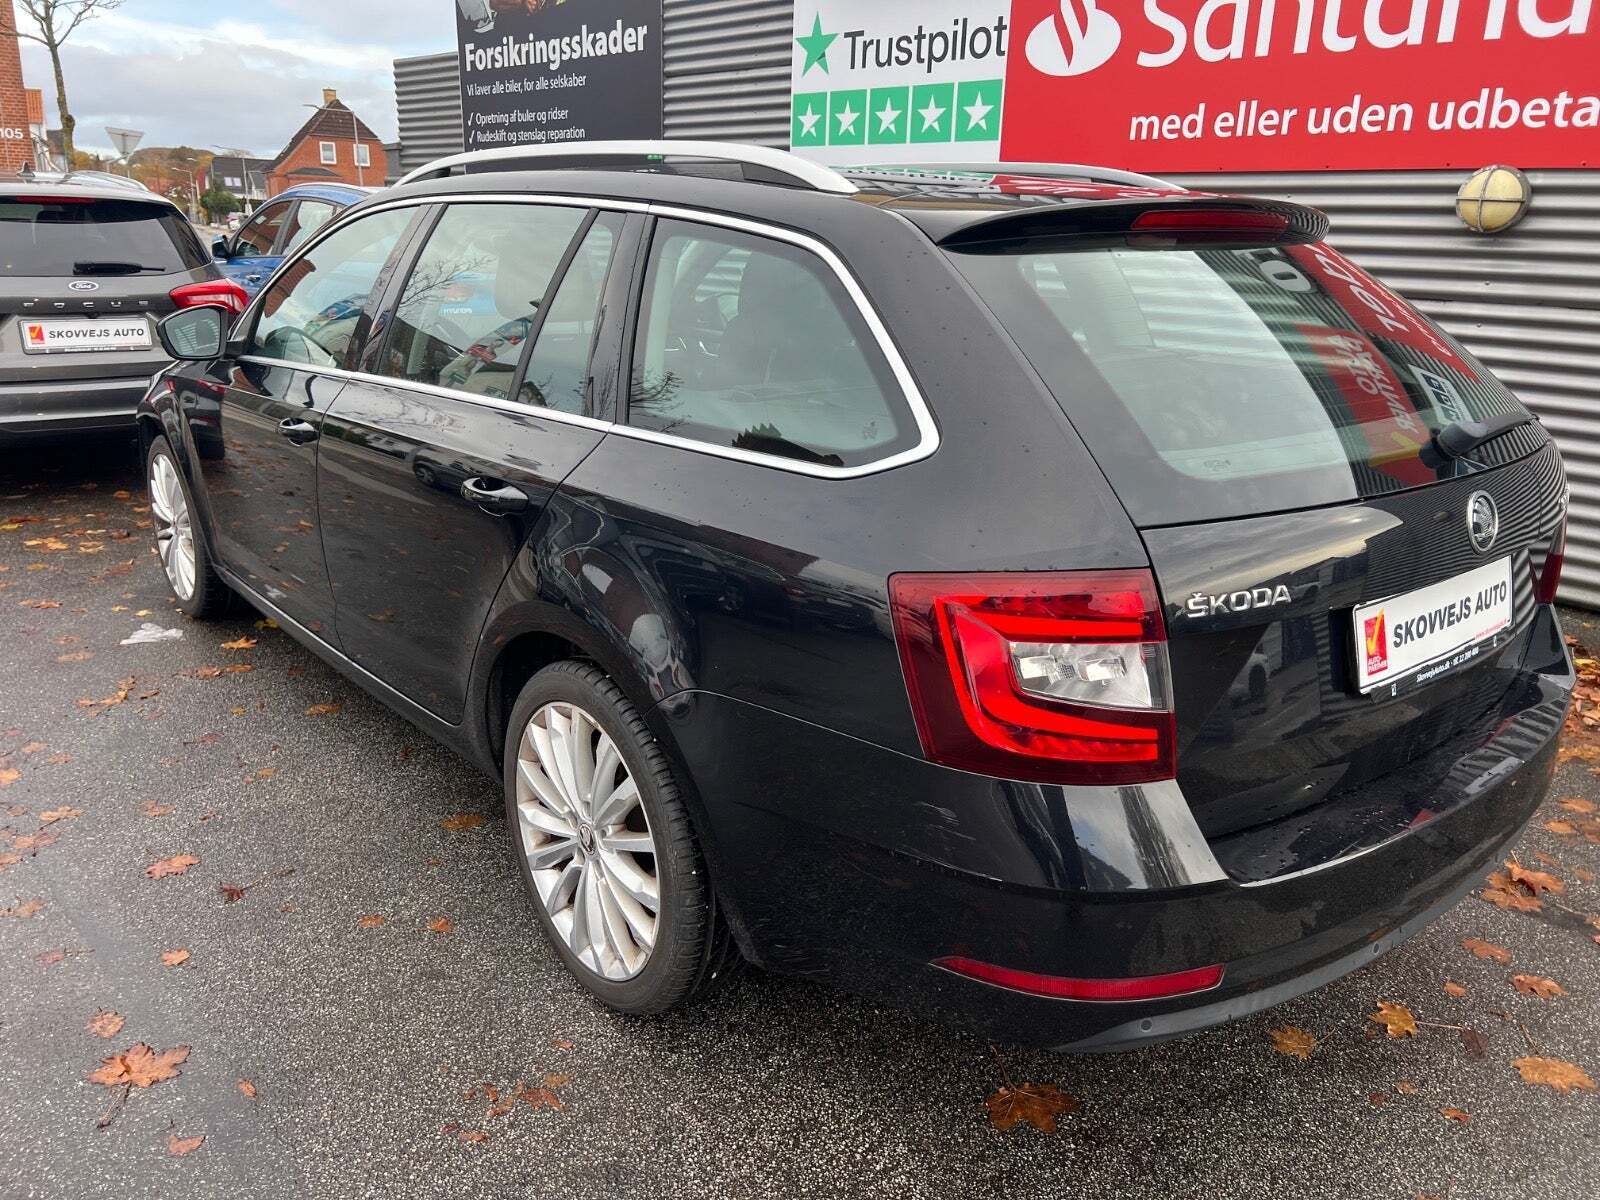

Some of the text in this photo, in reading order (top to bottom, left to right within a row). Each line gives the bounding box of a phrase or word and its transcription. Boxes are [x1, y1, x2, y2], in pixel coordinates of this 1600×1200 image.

[464, 19, 648, 72] Forsikringsskader
[843, 16, 1007, 73] Trustpilot
[466, 83, 475, 96] Vi
[474, 82, 491, 95] laver
[492, 81, 504, 95] alle
[524, 77, 535, 92] for
[535, 76, 549, 90] alle
[550, 73, 586, 89] selskaber
[475, 107, 569, 127] Opretning af buler og ridser
[1129, 103, 1206, 141] med
[1213, 99, 1298, 139] eller
[1306, 94, 1414, 135] uden
[476, 126, 586, 144] Rudeskift og stenslag reparation
[48, 328, 145, 339] SKOVVEJS AUTO
[1186, 584, 1292, 618] ŠKODA
[1393, 596, 1472, 649] SKOVVEJS
[1474, 581, 1507, 615] AUTO
